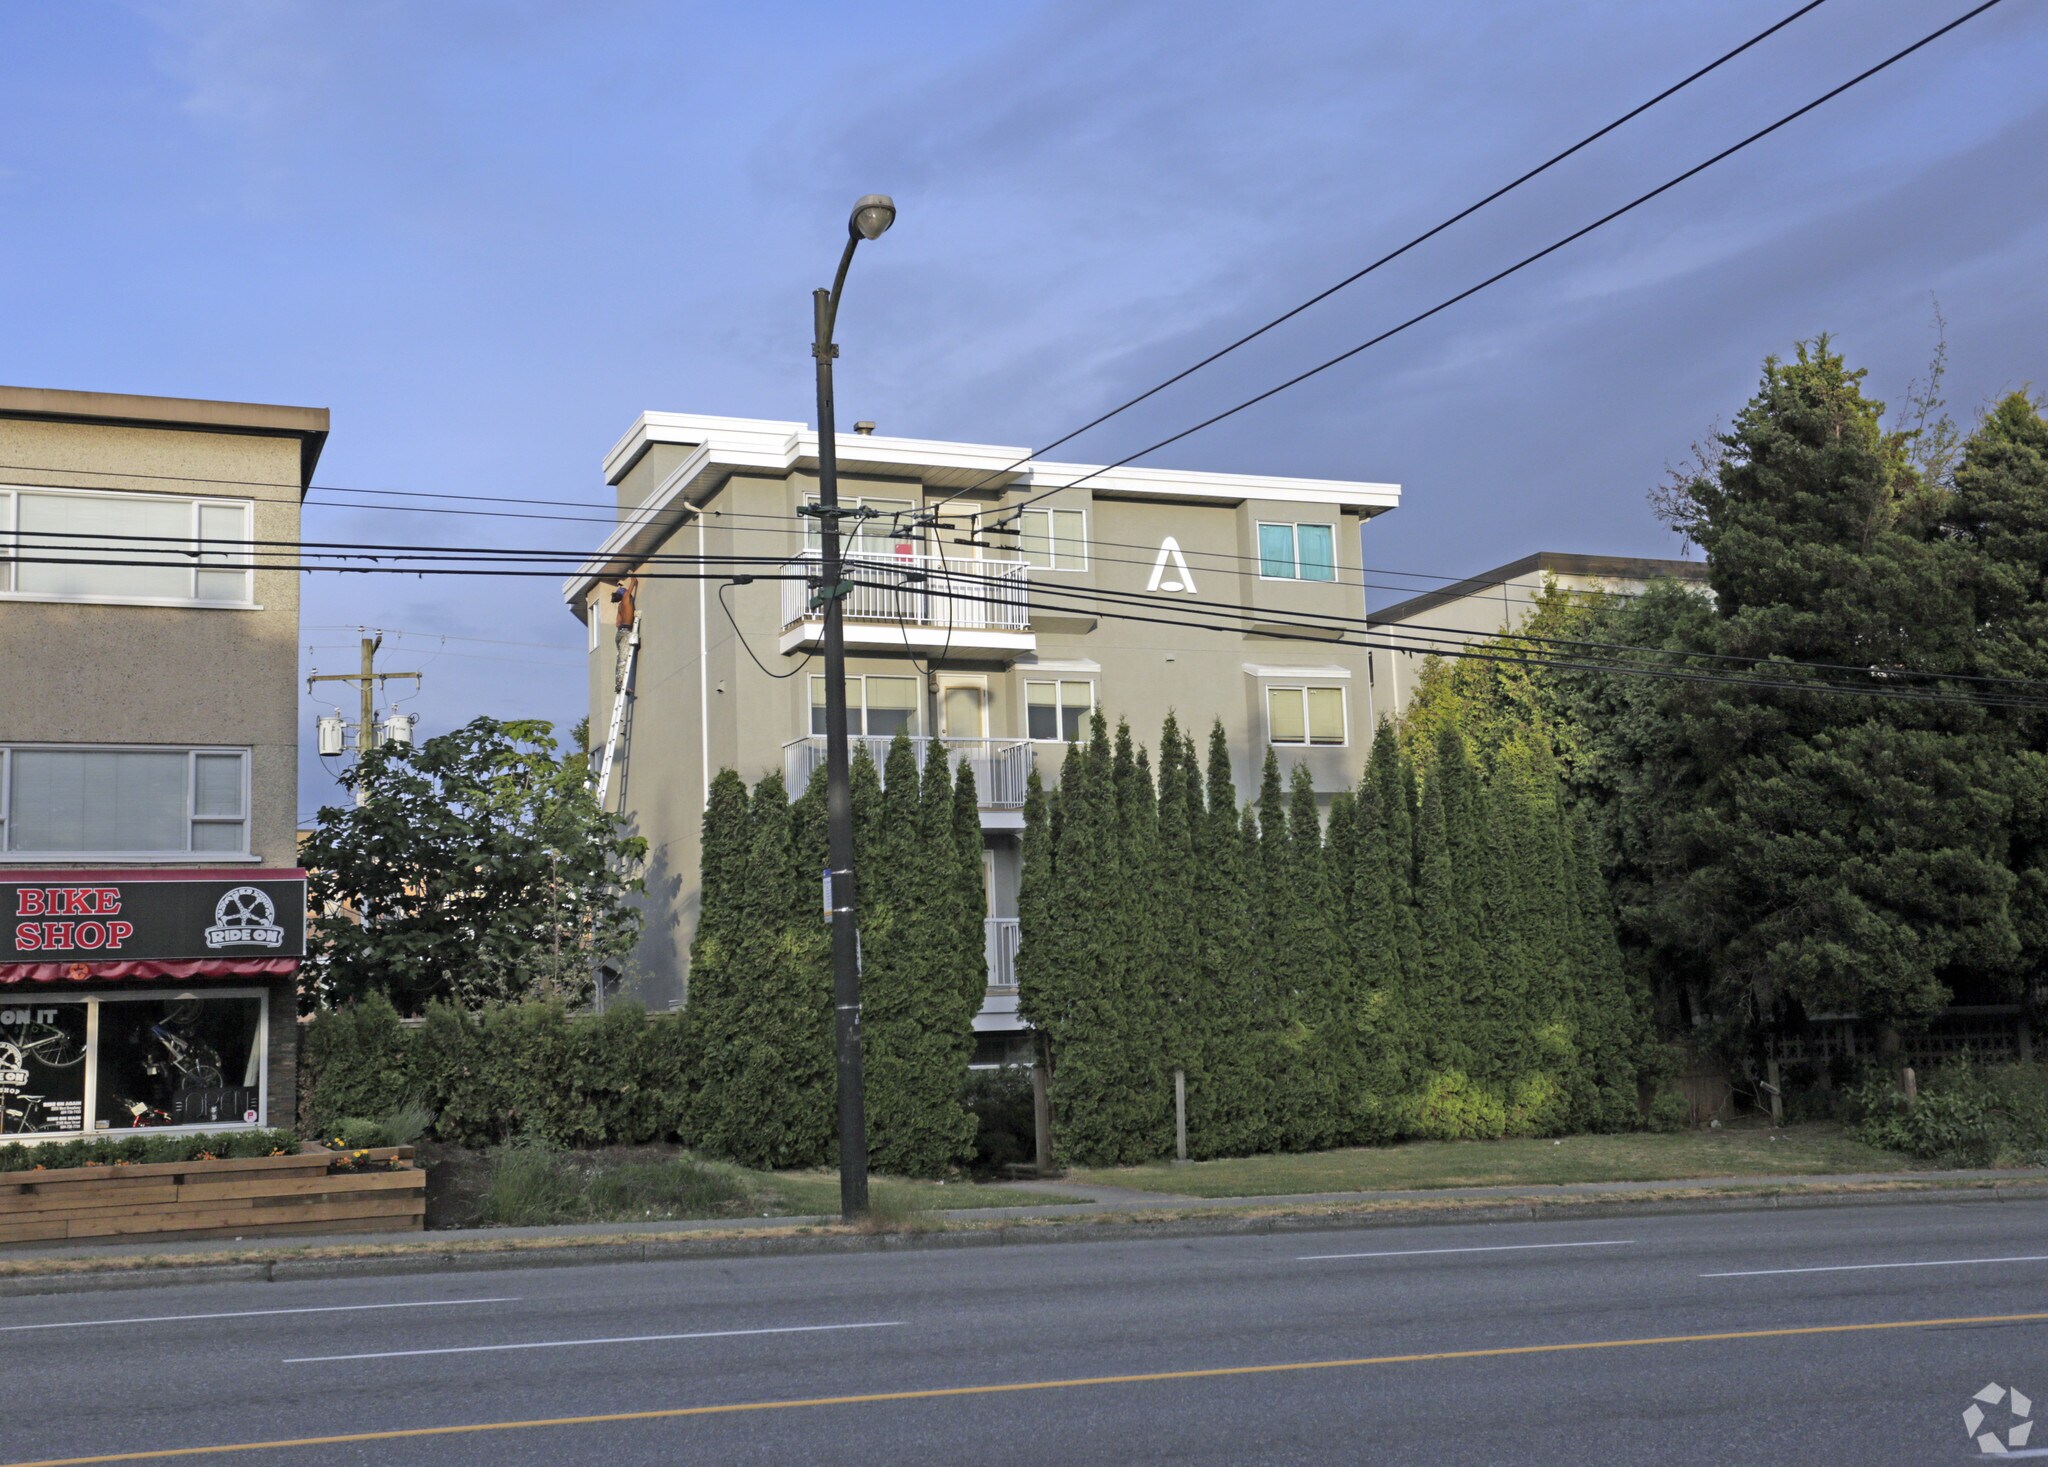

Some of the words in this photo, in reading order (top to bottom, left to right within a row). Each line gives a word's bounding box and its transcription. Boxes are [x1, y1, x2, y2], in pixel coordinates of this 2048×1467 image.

[16, 888, 122, 916] BIKE
[15, 921, 134, 950] SHOP
[211, 929, 252, 943] RIDE
[253, 930, 279, 943] ON
[0, 1010, 31, 1025] ON
[37, 1009, 58, 1024] IT
